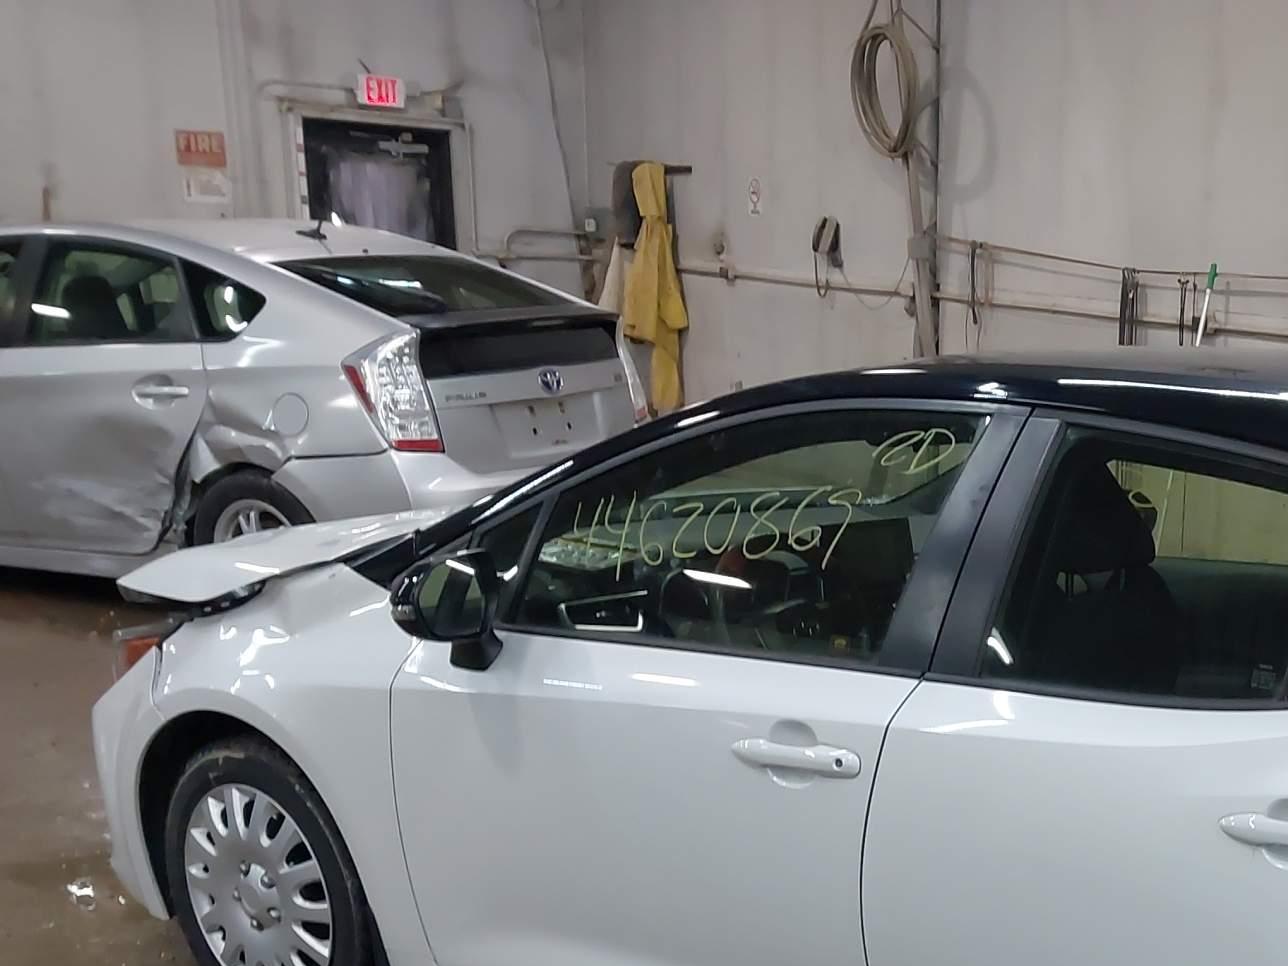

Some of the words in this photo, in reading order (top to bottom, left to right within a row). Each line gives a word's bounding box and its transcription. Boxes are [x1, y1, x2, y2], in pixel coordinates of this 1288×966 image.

[366, 76, 398, 105] EXIT
[178, 132, 224, 152] FIRE
[572, 486, 863, 583] 44620869
